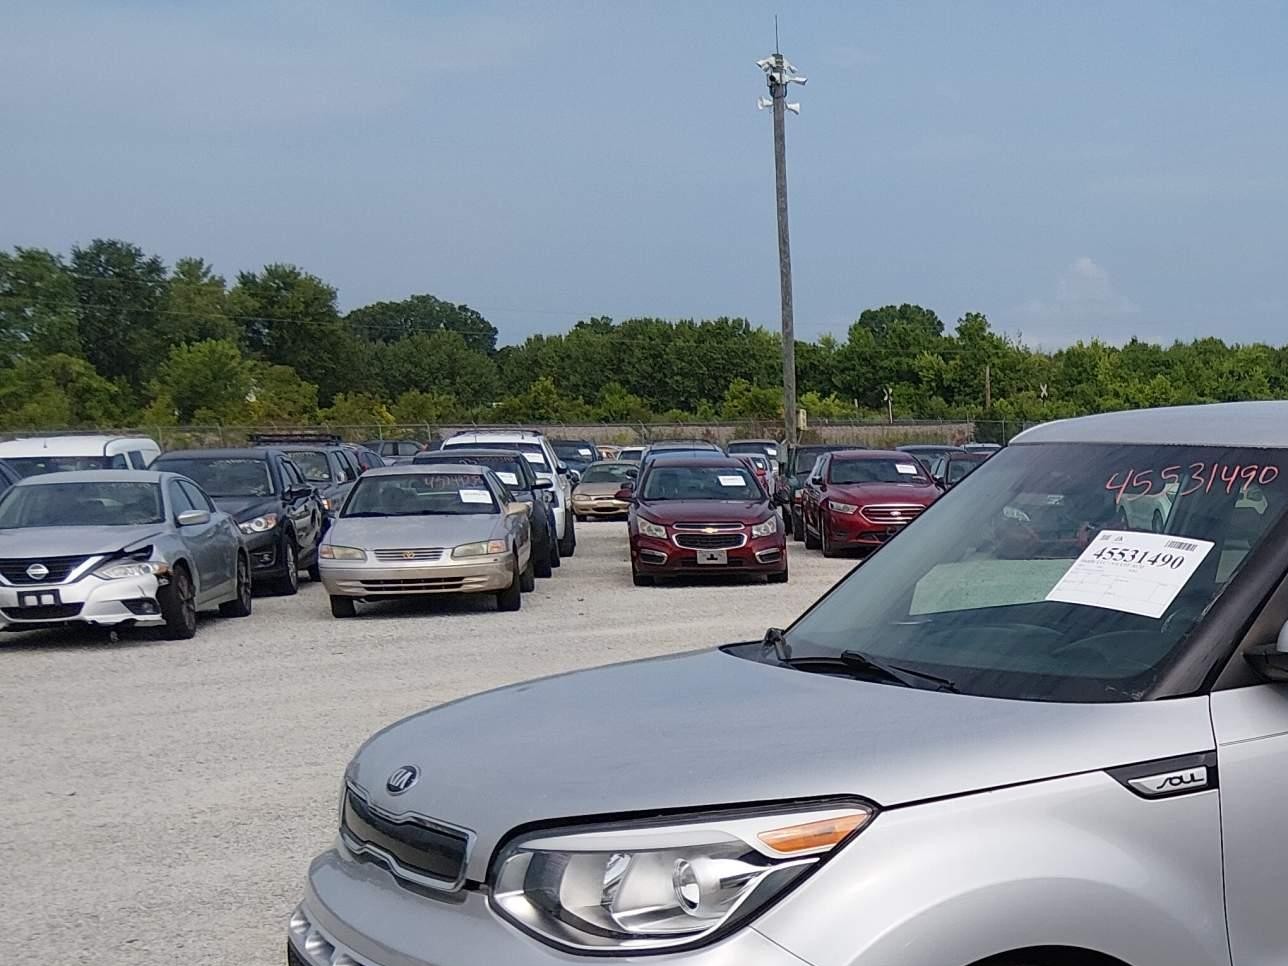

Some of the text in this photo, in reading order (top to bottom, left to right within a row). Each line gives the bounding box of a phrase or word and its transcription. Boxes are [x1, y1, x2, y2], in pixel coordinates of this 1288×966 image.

[1105, 462, 1279, 504] 45531490
[1093, 547, 1185, 570] 45531490
[1156, 773, 1204, 789] SOUL
